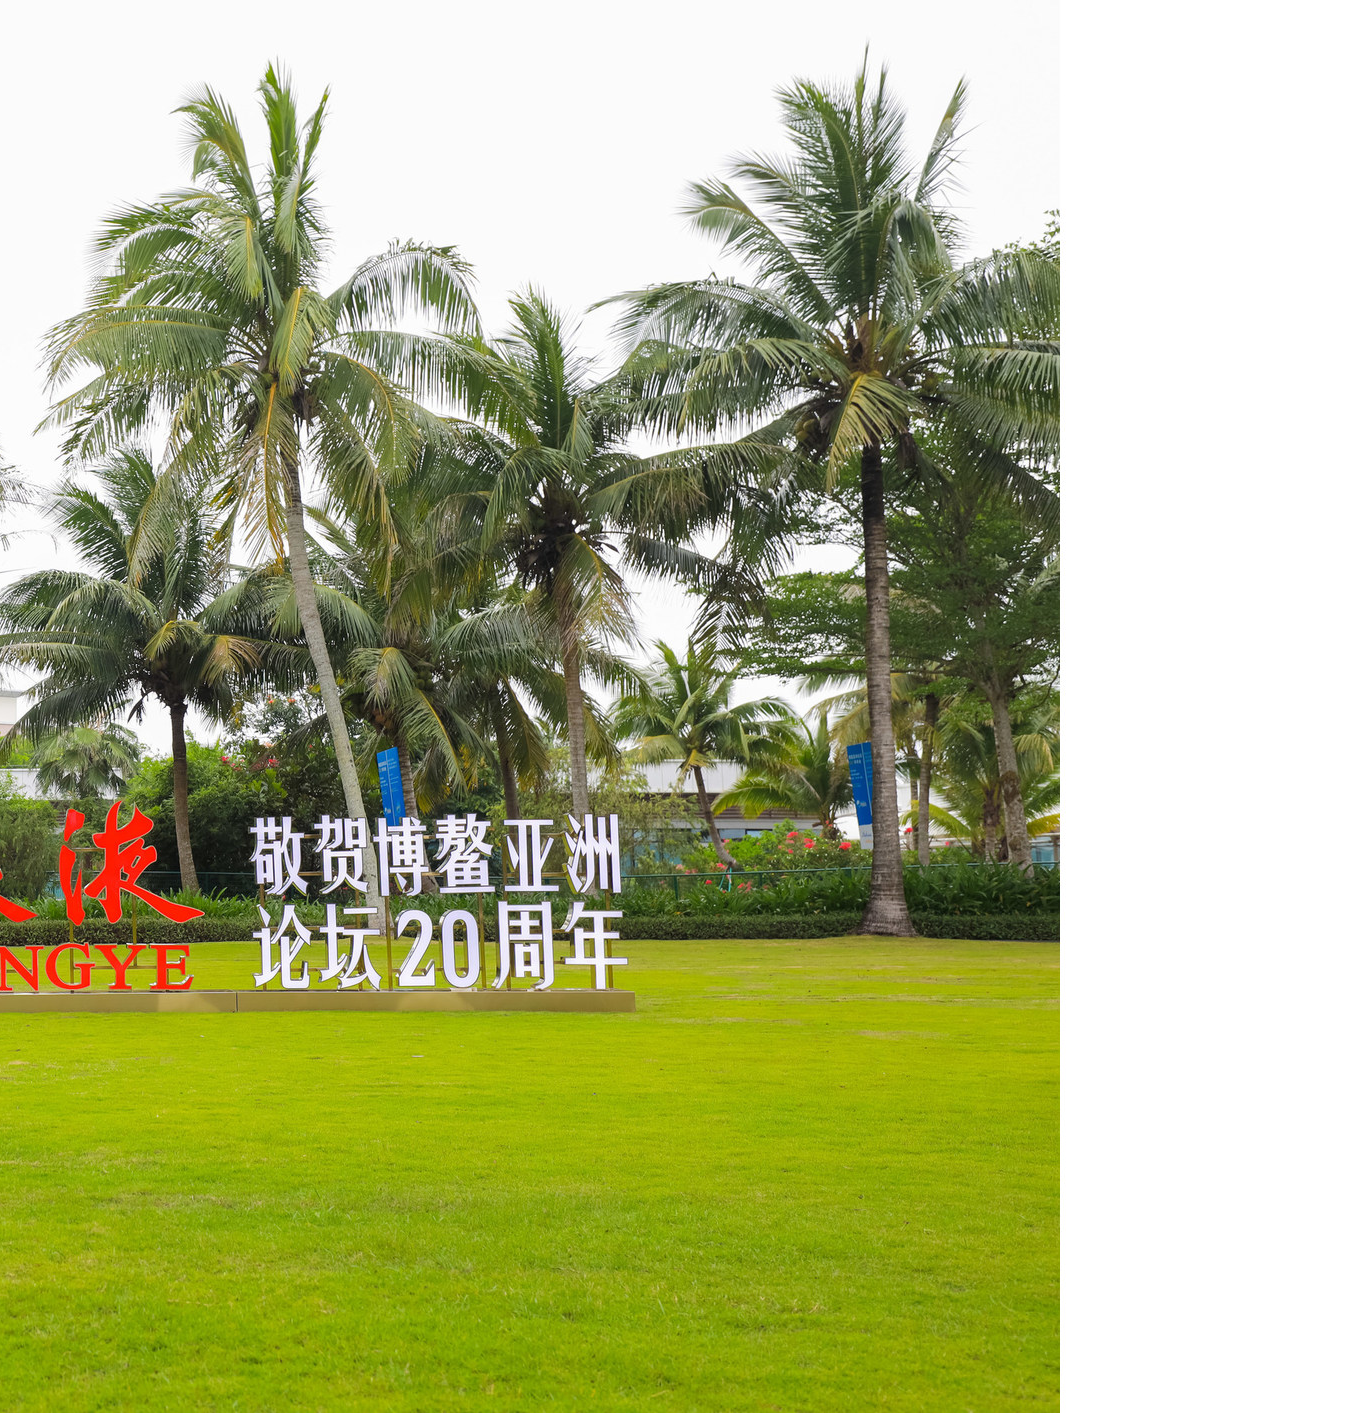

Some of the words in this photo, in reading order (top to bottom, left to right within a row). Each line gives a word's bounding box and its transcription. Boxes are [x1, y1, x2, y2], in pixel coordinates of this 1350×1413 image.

[250, 813, 622, 897] 敬贺博鳌亚洲
[252, 901, 629, 990] 论坛20周年
